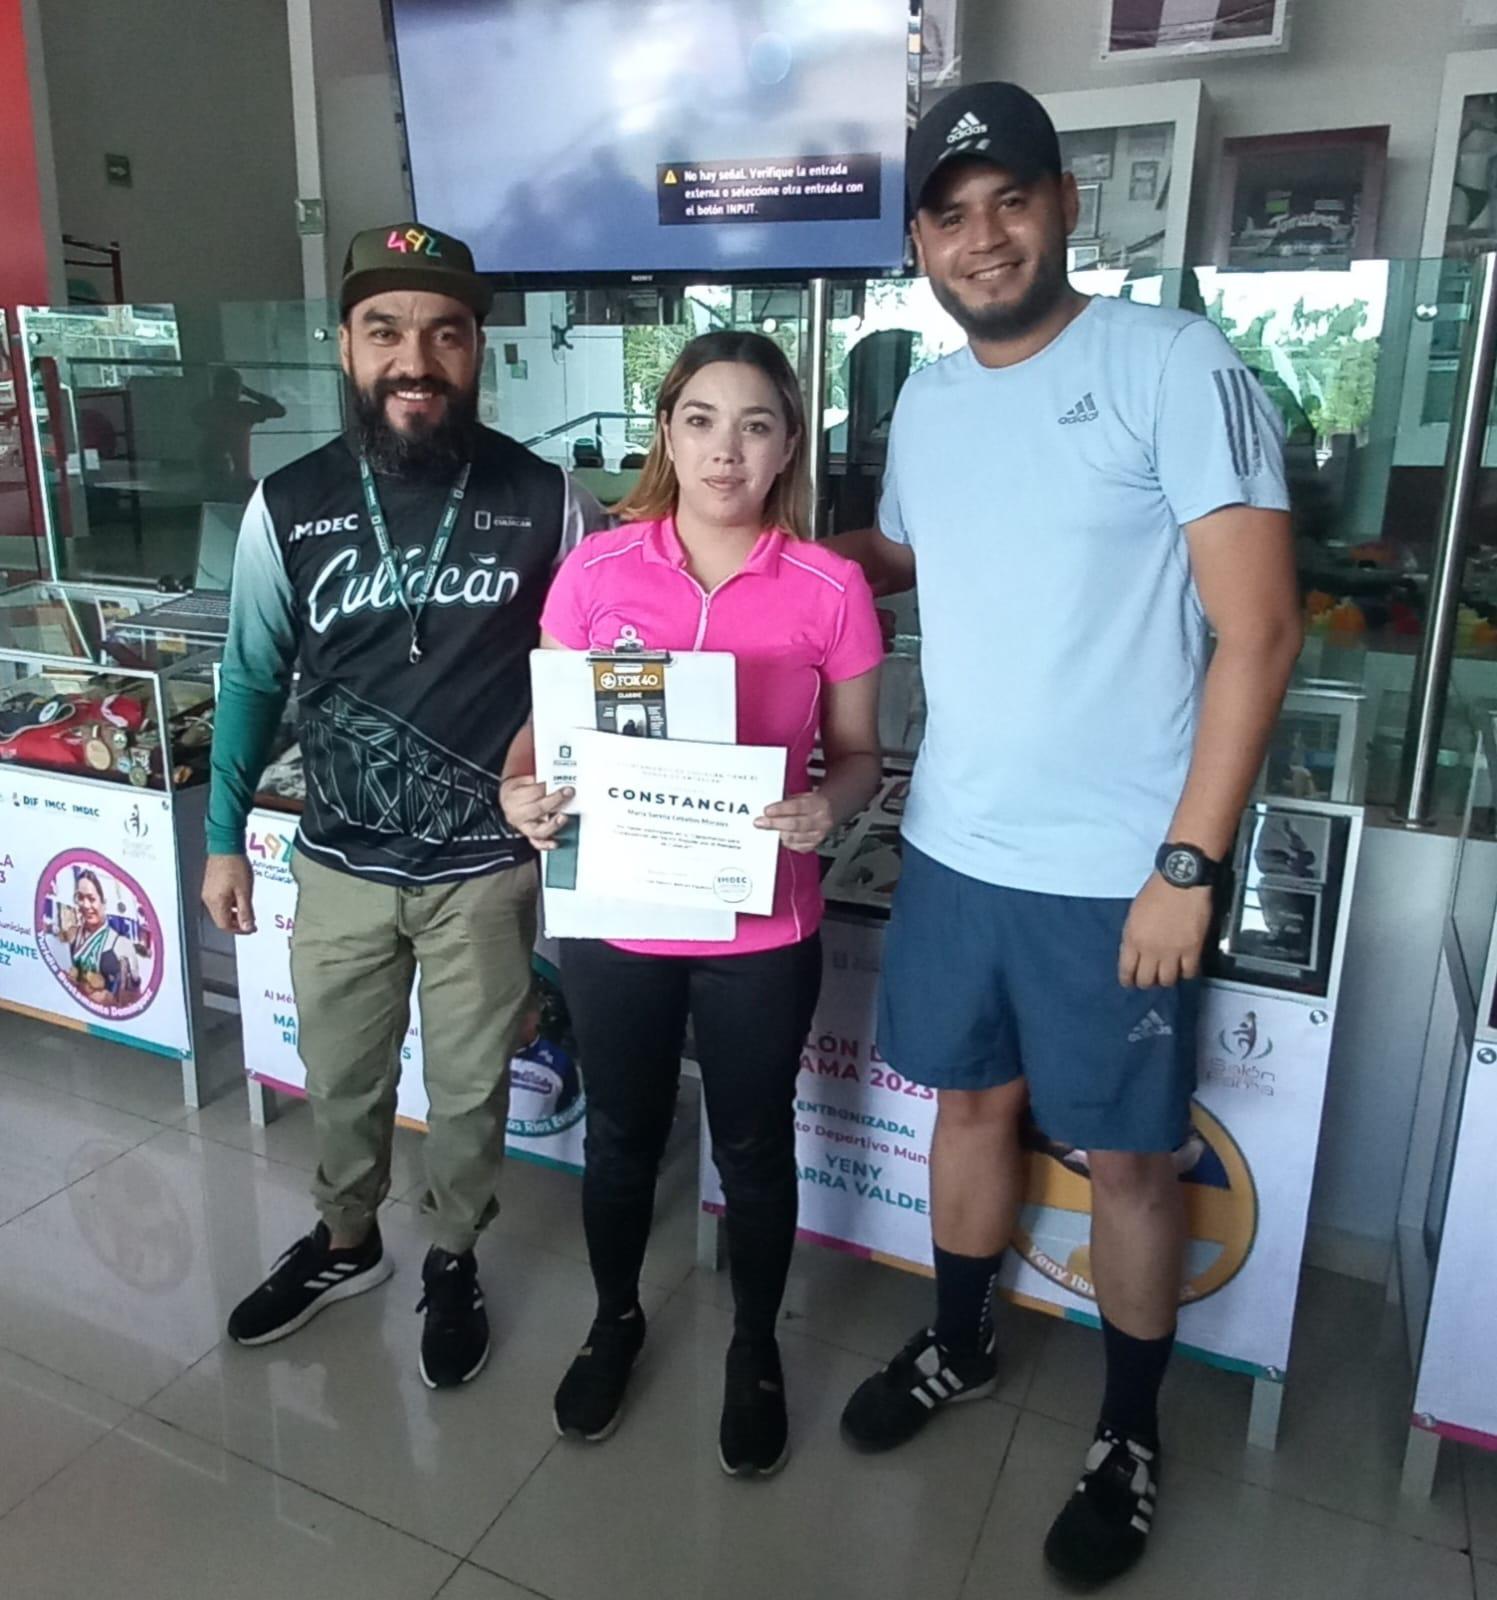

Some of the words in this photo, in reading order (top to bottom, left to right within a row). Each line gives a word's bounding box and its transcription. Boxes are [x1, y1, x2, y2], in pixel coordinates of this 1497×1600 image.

[946, 124, 988, 144] adidas
[684, 171, 697, 182] No
[699, 170, 717, 183] hay
[719, 168, 748, 181] señal.
[749, 166, 794, 182] Verifique
[796, 165, 806, 177] la
[808, 163, 848, 176] entrada
[685, 187, 720, 199] externa
[723, 189, 729, 198] o
[731, 185, 780, 197] seleccione
[781, 184, 802, 196] otra
[804, 182, 844, 194] entrada
[845, 182, 864, 194] con
[685, 205, 695, 217] el
[697, 203, 725, 216] botón
[726, 203, 759, 215] INPUT.
[387, 228, 442, 258] 492
[289, 513, 360, 543] IMDEC
[617, 674, 641, 686] FOX
[641, 674, 659, 686] 40
[23, 795, 39, 806] DIF
[45, 798, 67, 812] IMCC
[73, 804, 101, 817] IMDEC
[607, 786, 751, 815] CONSTANCIA
[717, 876, 748, 885] IMDEC
[869, 1067, 935, 1101] 2023
[797, 1100, 916, 1139] ENTRONIZADA:
[814, 1125, 890, 1154] Deportivo
[825, 1153, 883, 1181] YENY
[1028, 1245, 1069, 1281] Yeny
